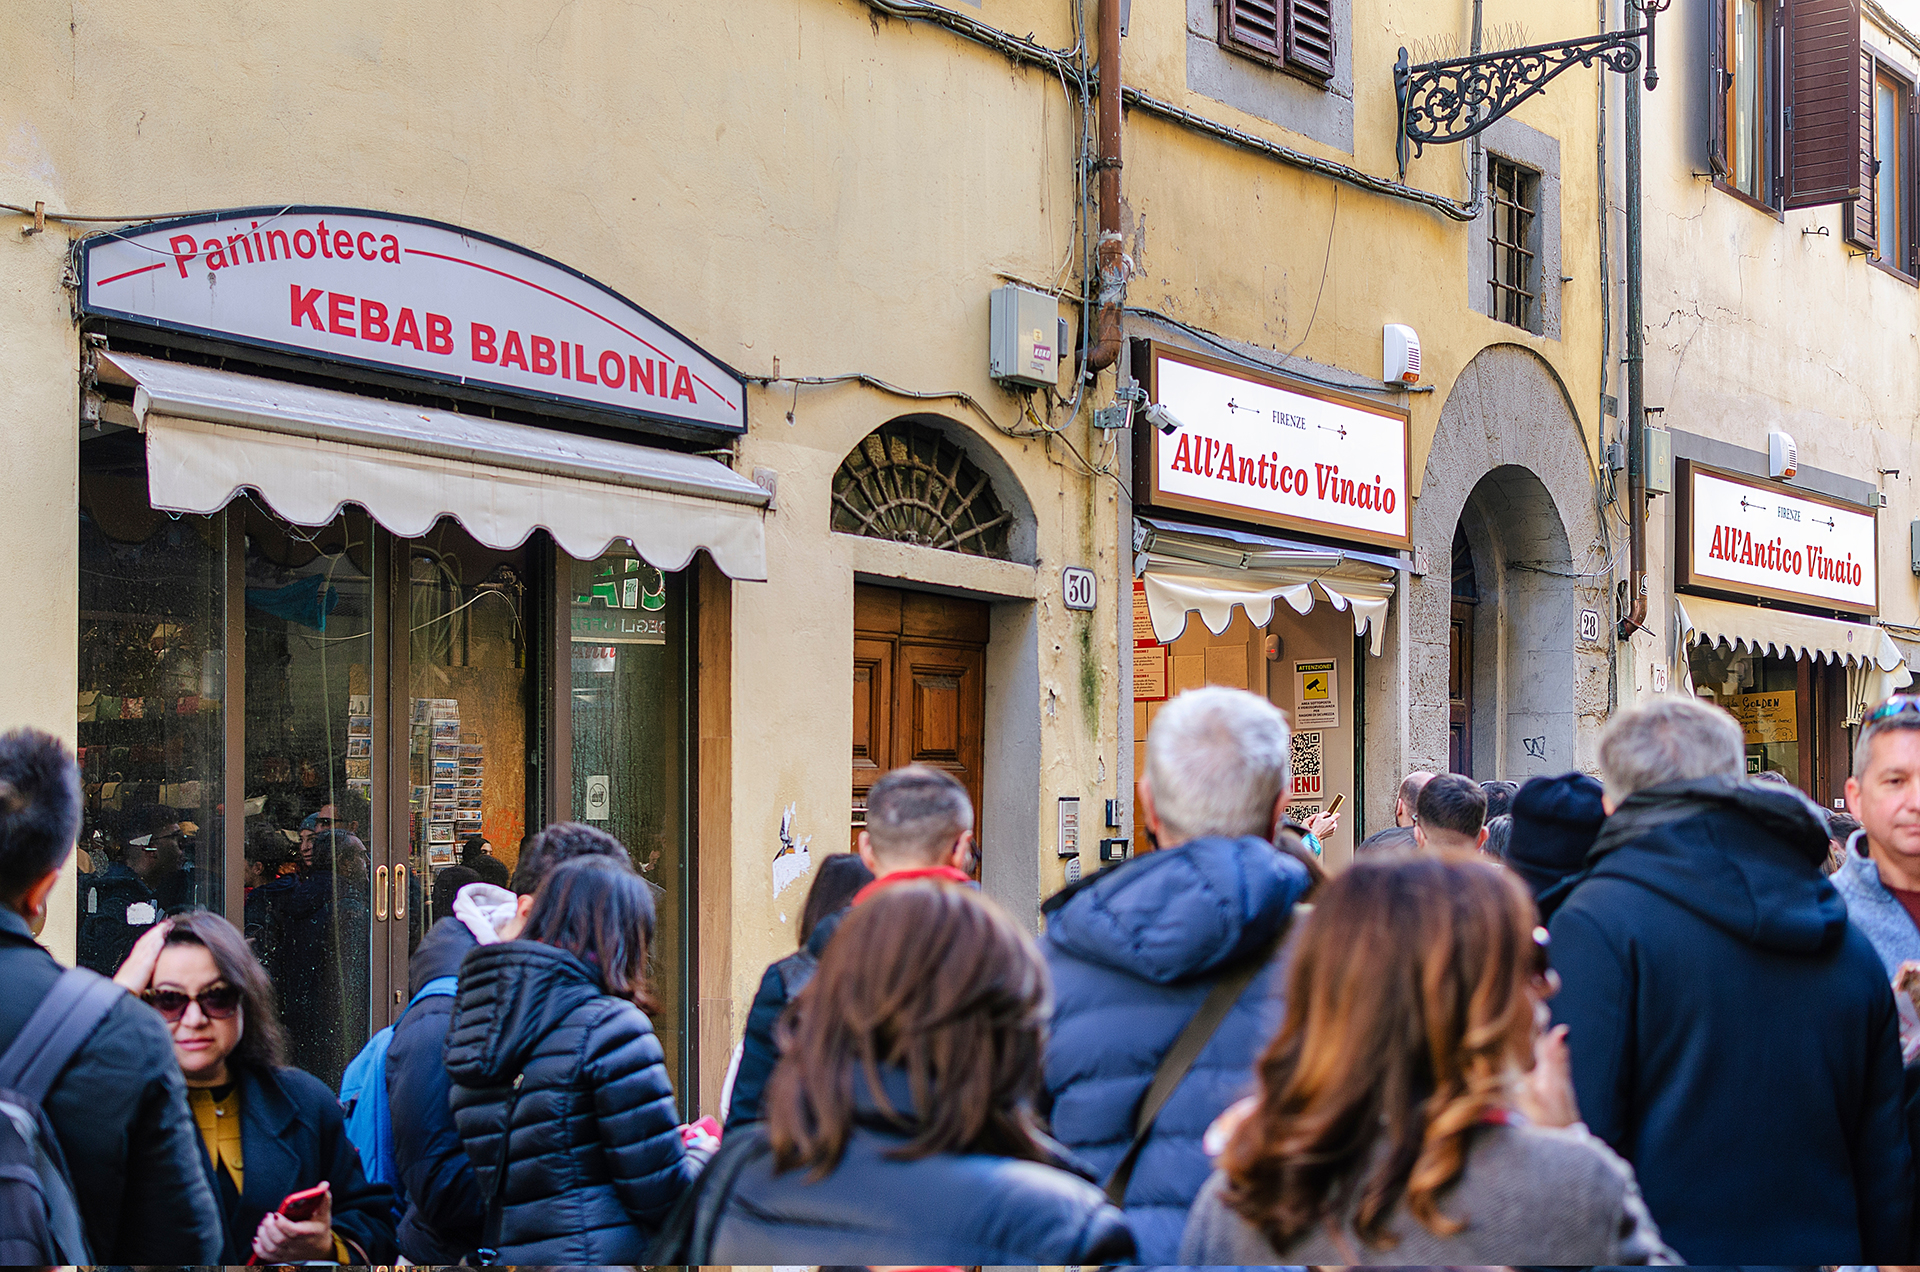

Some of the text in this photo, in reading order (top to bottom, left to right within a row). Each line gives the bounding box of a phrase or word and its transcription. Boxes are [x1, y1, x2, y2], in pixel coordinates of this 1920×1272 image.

[169, 219, 401, 279] Paninoteca
[290, 283, 697, 404] KEBAB BABILONIA
[1272, 410, 1306, 430] FIRENZE
[1171, 433, 1396, 514] All'Antico Vinaio
[1777, 505, 1801, 522] FIRENZE
[1416, 551, 1429, 571] 78
[1709, 525, 1862, 587] All'Antico Vinaio
[1069, 574, 1091, 604] 30
[1583, 614, 1596, 637] 28
[1656, 669, 1666, 687] 76
[1291, 775, 1320, 793] ENU
